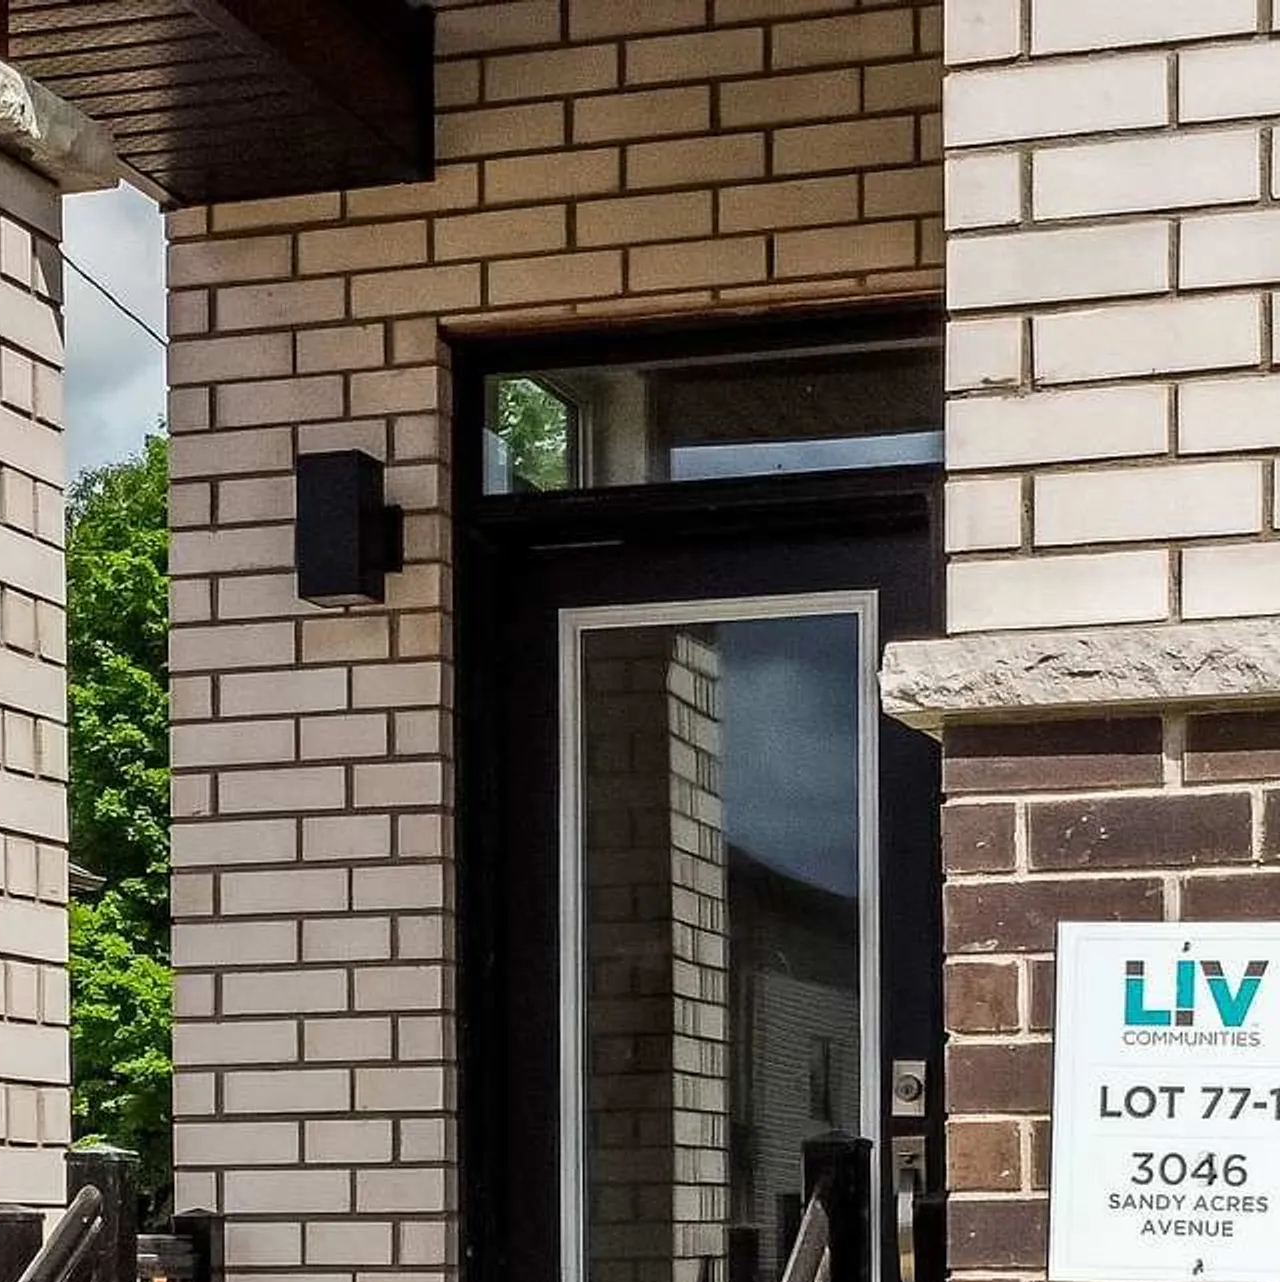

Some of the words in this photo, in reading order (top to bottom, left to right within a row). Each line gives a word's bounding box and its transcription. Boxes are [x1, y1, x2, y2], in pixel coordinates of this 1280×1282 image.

[1124, 960, 1270, 1027] LIV
[1122, 1030, 1262, 1047] COMMUNITIES
[1099, 1085, 1186, 1119] LOT
[1130, 1152, 1248, 1187] 3046
[1108, 1193, 1186, 1211] SANDY
[1193, 1195, 1269, 1213] ACRES
[1140, 1219, 1234, 1237] AVENUE
